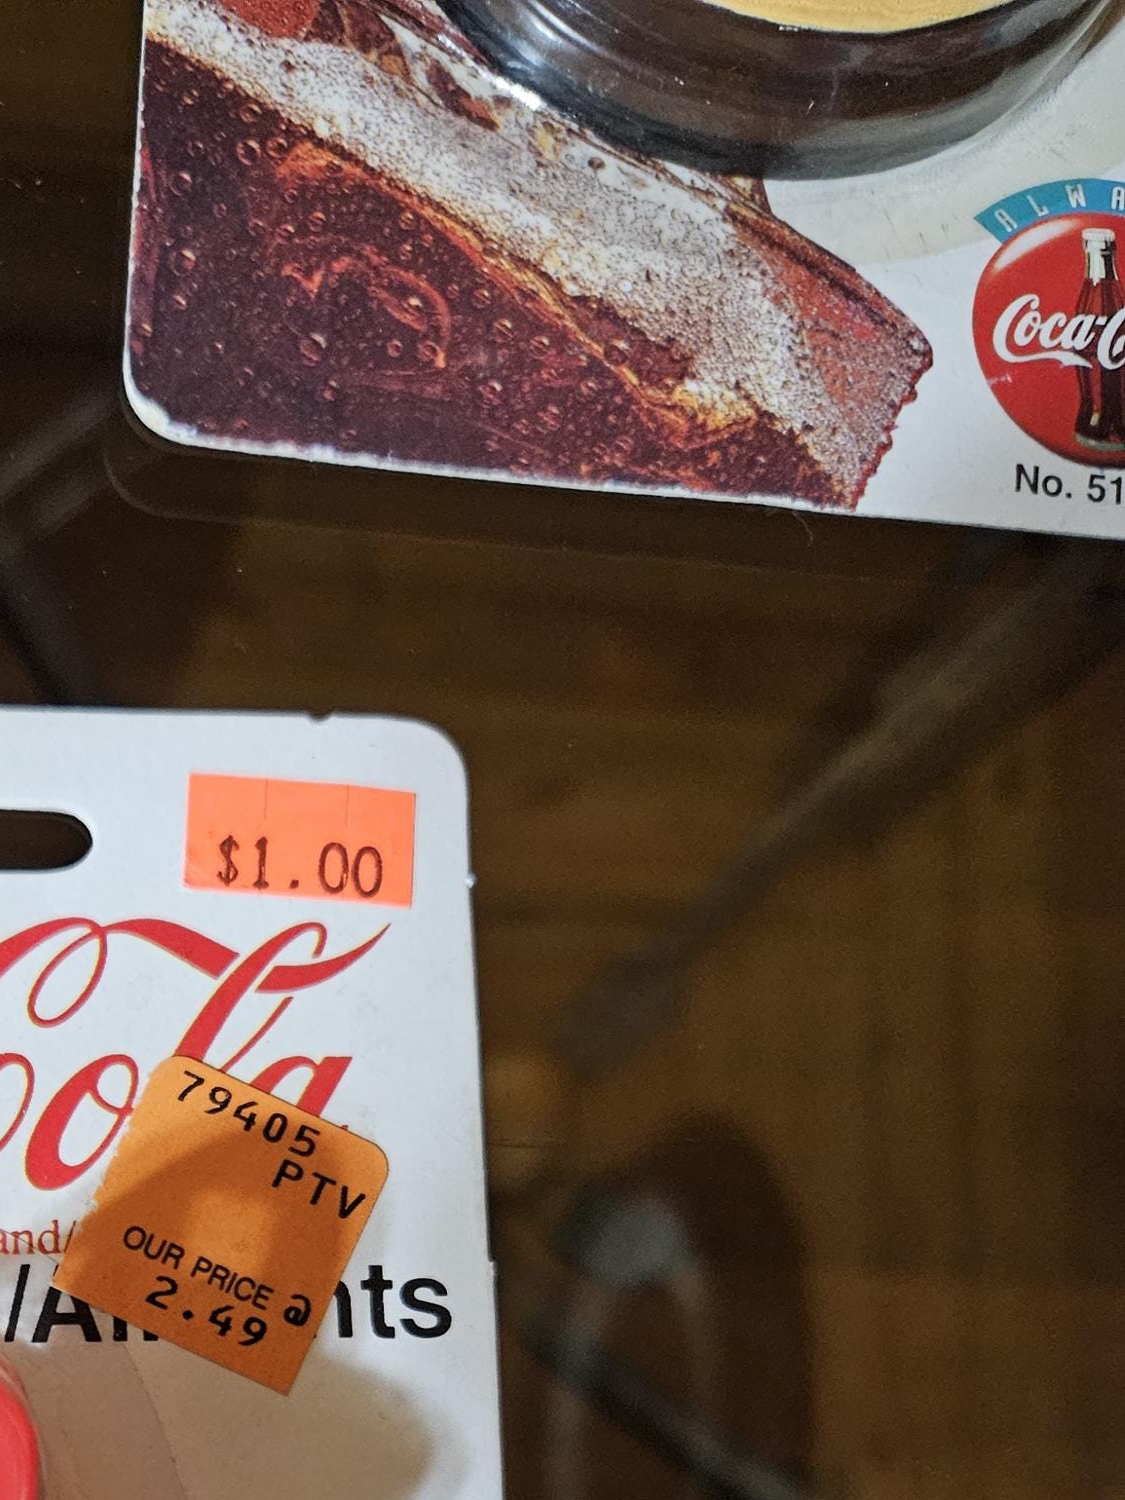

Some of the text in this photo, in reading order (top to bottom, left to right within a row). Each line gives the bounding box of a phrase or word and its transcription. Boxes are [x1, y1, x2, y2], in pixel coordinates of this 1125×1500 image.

[1014, 463, 1123, 505] No. 51
[216, 834, 383, 898] $1.00
[176, 1070, 322, 1158] 79405
[271, 1158, 366, 1220] PTV
[122, 1225, 185, 1270] OUR
[190, 1258, 275, 1312] PRICE
[144, 1274, 268, 1347] 2.49
